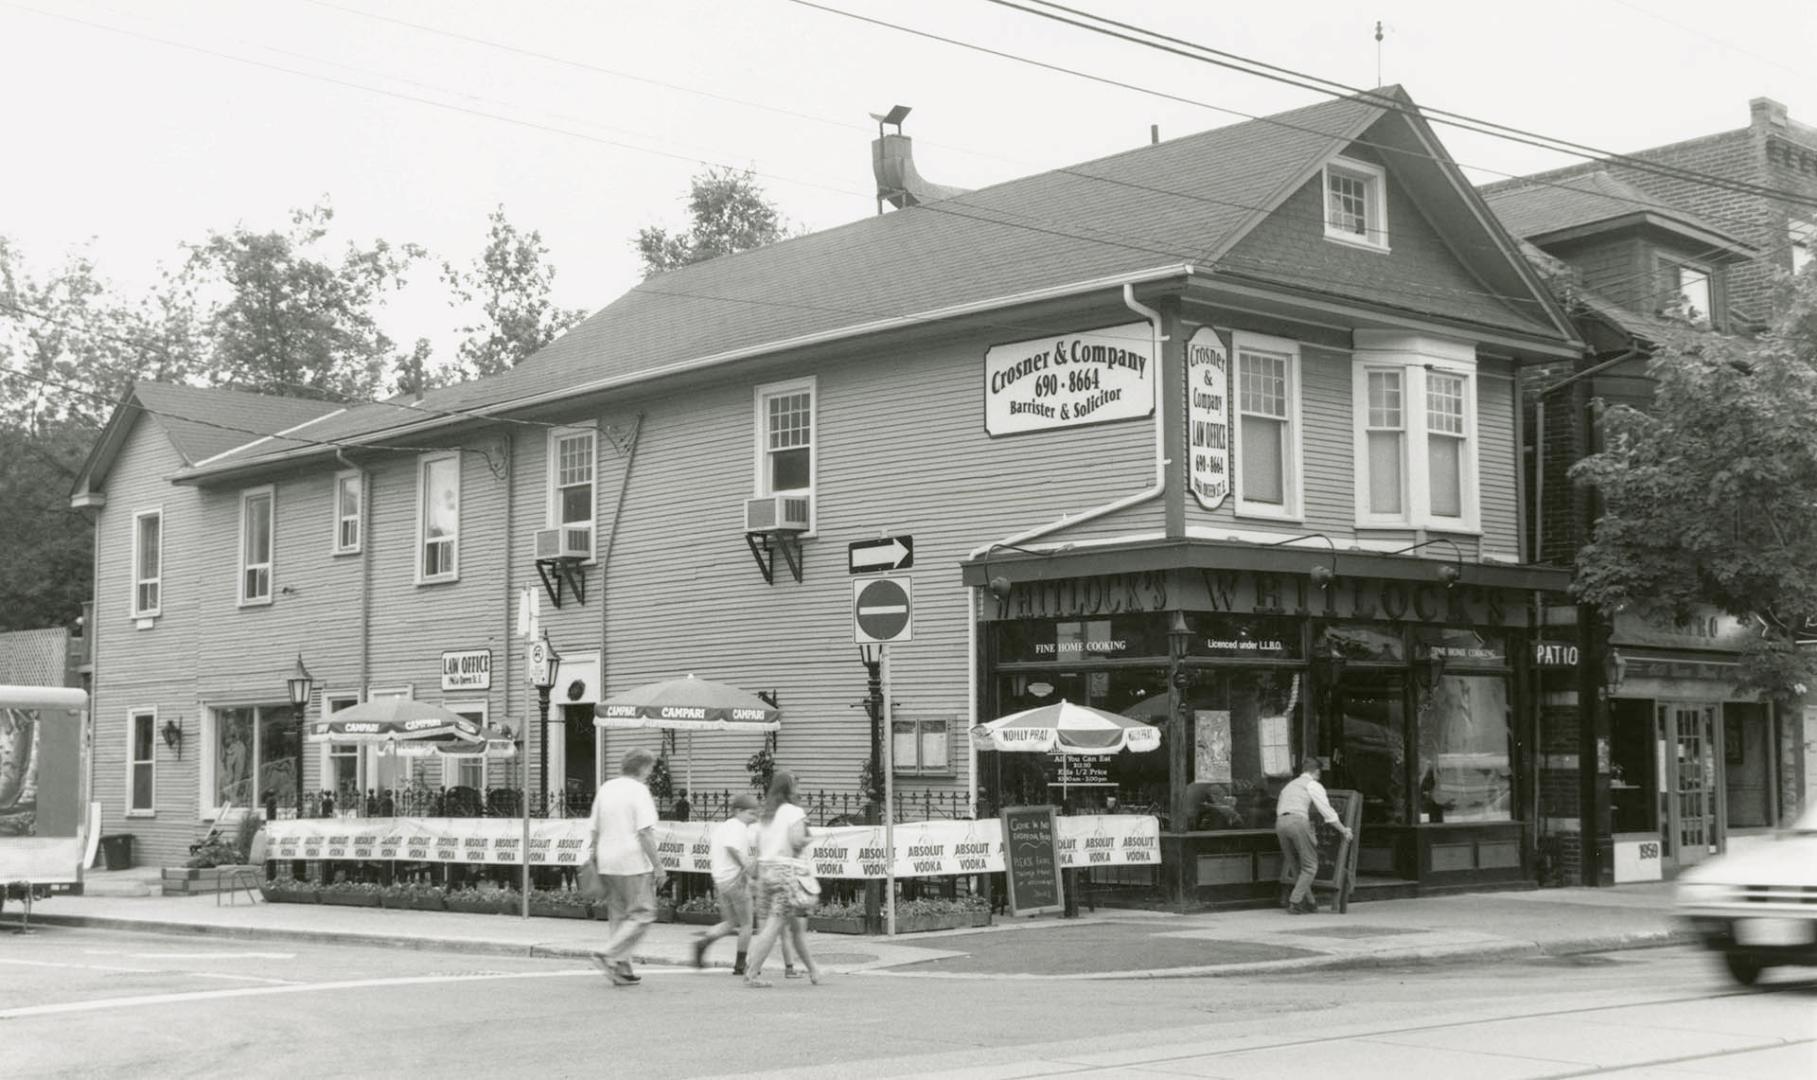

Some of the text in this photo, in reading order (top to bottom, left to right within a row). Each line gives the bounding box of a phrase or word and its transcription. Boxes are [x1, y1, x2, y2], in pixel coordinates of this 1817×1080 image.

[991, 340, 1147, 395] Crosner & Company
[1190, 344, 1225, 373] Crosner
[1035, 374, 1057, 398] 690
[1069, 368, 1100, 393] 8664
[1204, 369, 1213, 386] &
[1010, 388, 1122, 420] Barrister & Solicitor
[1193, 387, 1222, 416] Company
[1193, 420, 1226, 450] LAW OFFICE
[1034, 640, 1126, 654] FINE HOME COOKING
[1239, 640, 1258, 650] under
[1537, 644, 1578, 666] PATIO
[443, 655, 489, 675] LAW OFFICE
[607, 706, 636, 717] CAMPARI
[661, 707, 705, 719] CAMPARI
[733, 709, 765, 720] CAMPARI
[1082, 755, 1097, 763] Can
[529, 839, 552, 849] BSOLUT
[658, 842, 684, 853] ABSOLUT
[692, 844, 711, 855] ABSO
[813, 847, 849, 860] ABSOLUT
[859, 848, 896, 860] ABSOLT
[908, 845, 944, 857] ABSOLUT
[954, 843, 990, 856] ABSOLUT
[1058, 838, 1077, 850] OLUT
[1085, 837, 1115, 849] ABSOLUT
[1123, 836, 1155, 848] ABSOLUT
[694, 858, 711, 870] VODK
[816, 863, 844, 875] VODKA
[863, 864, 888, 876] VODK
[913, 860, 942, 873] VODKA
[960, 858, 987, 871] VODKA
[1089, 852, 1111, 864] VODKA
[1126, 851, 1151, 863] VODKA
